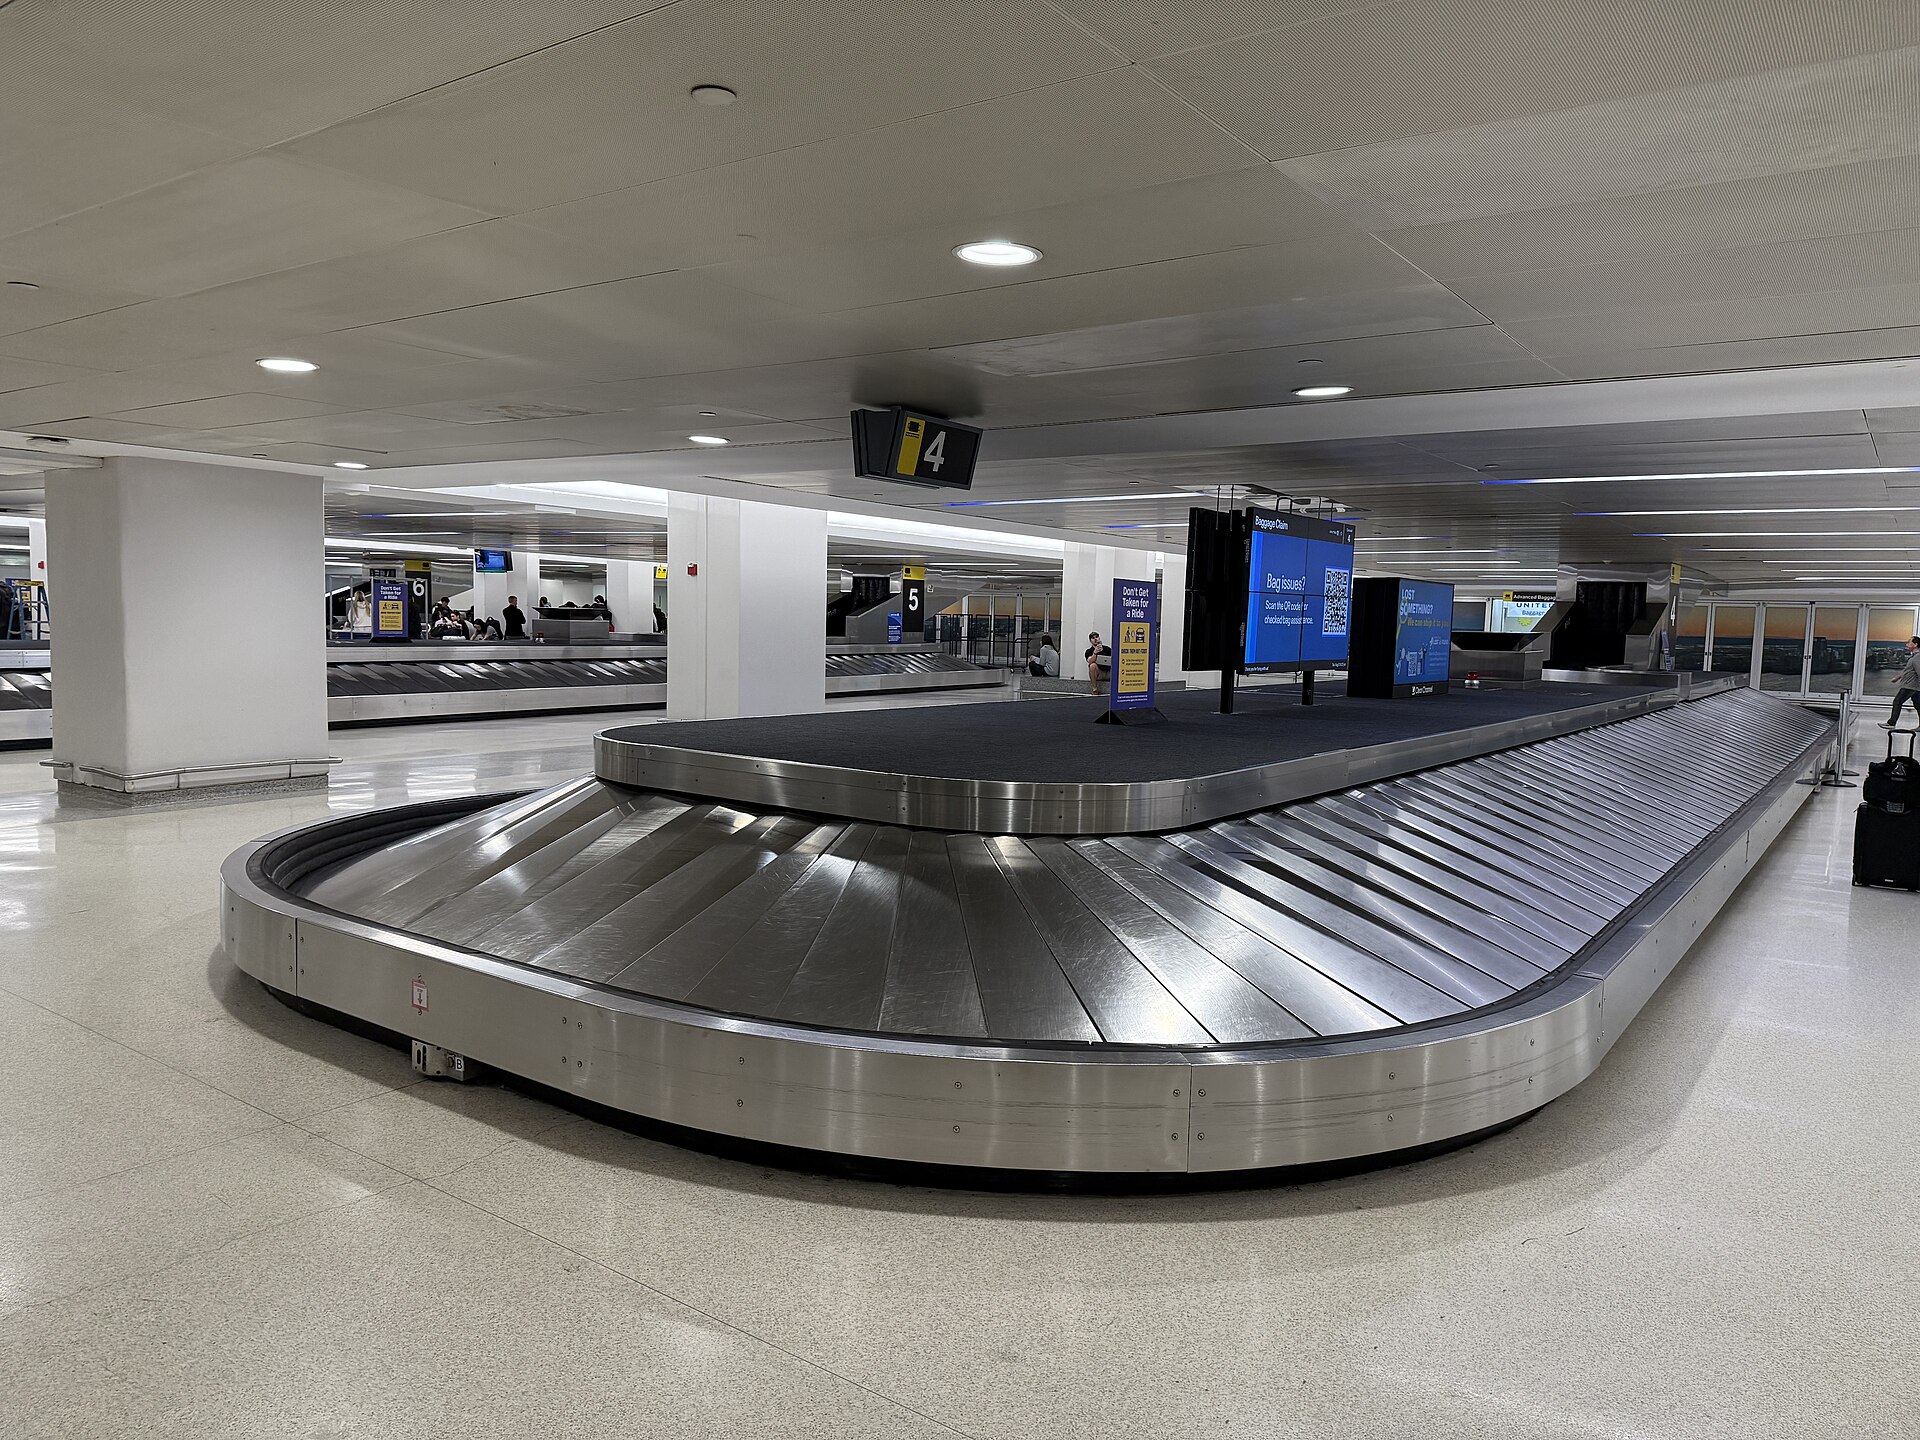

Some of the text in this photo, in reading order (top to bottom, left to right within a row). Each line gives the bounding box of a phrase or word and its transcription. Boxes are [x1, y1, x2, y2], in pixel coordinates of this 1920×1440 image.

[924, 431, 946, 472] 4
[1255, 516, 1288, 531] Baggage Claim
[413, 578, 425, 597] 6
[1267, 573, 1306, 593] Bag issues?
[1122, 586, 1149, 598] Don't Get
[1401, 588, 1416, 600] LOST
[909, 588, 919, 611] 5
[1122, 598, 1149, 608] Taken for
[1265, 600, 1276, 610] Scan
[1276, 601, 1284, 610] the
[1284, 600, 1291, 611] QR
[1126, 608, 1145, 619] a Ride
[1400, 602, 1434, 616] SOMETHING?
[1670, 596, 1676, 626] 4
[1264, 614, 1282, 624] checked
[1282, 615, 1291, 626] bag
